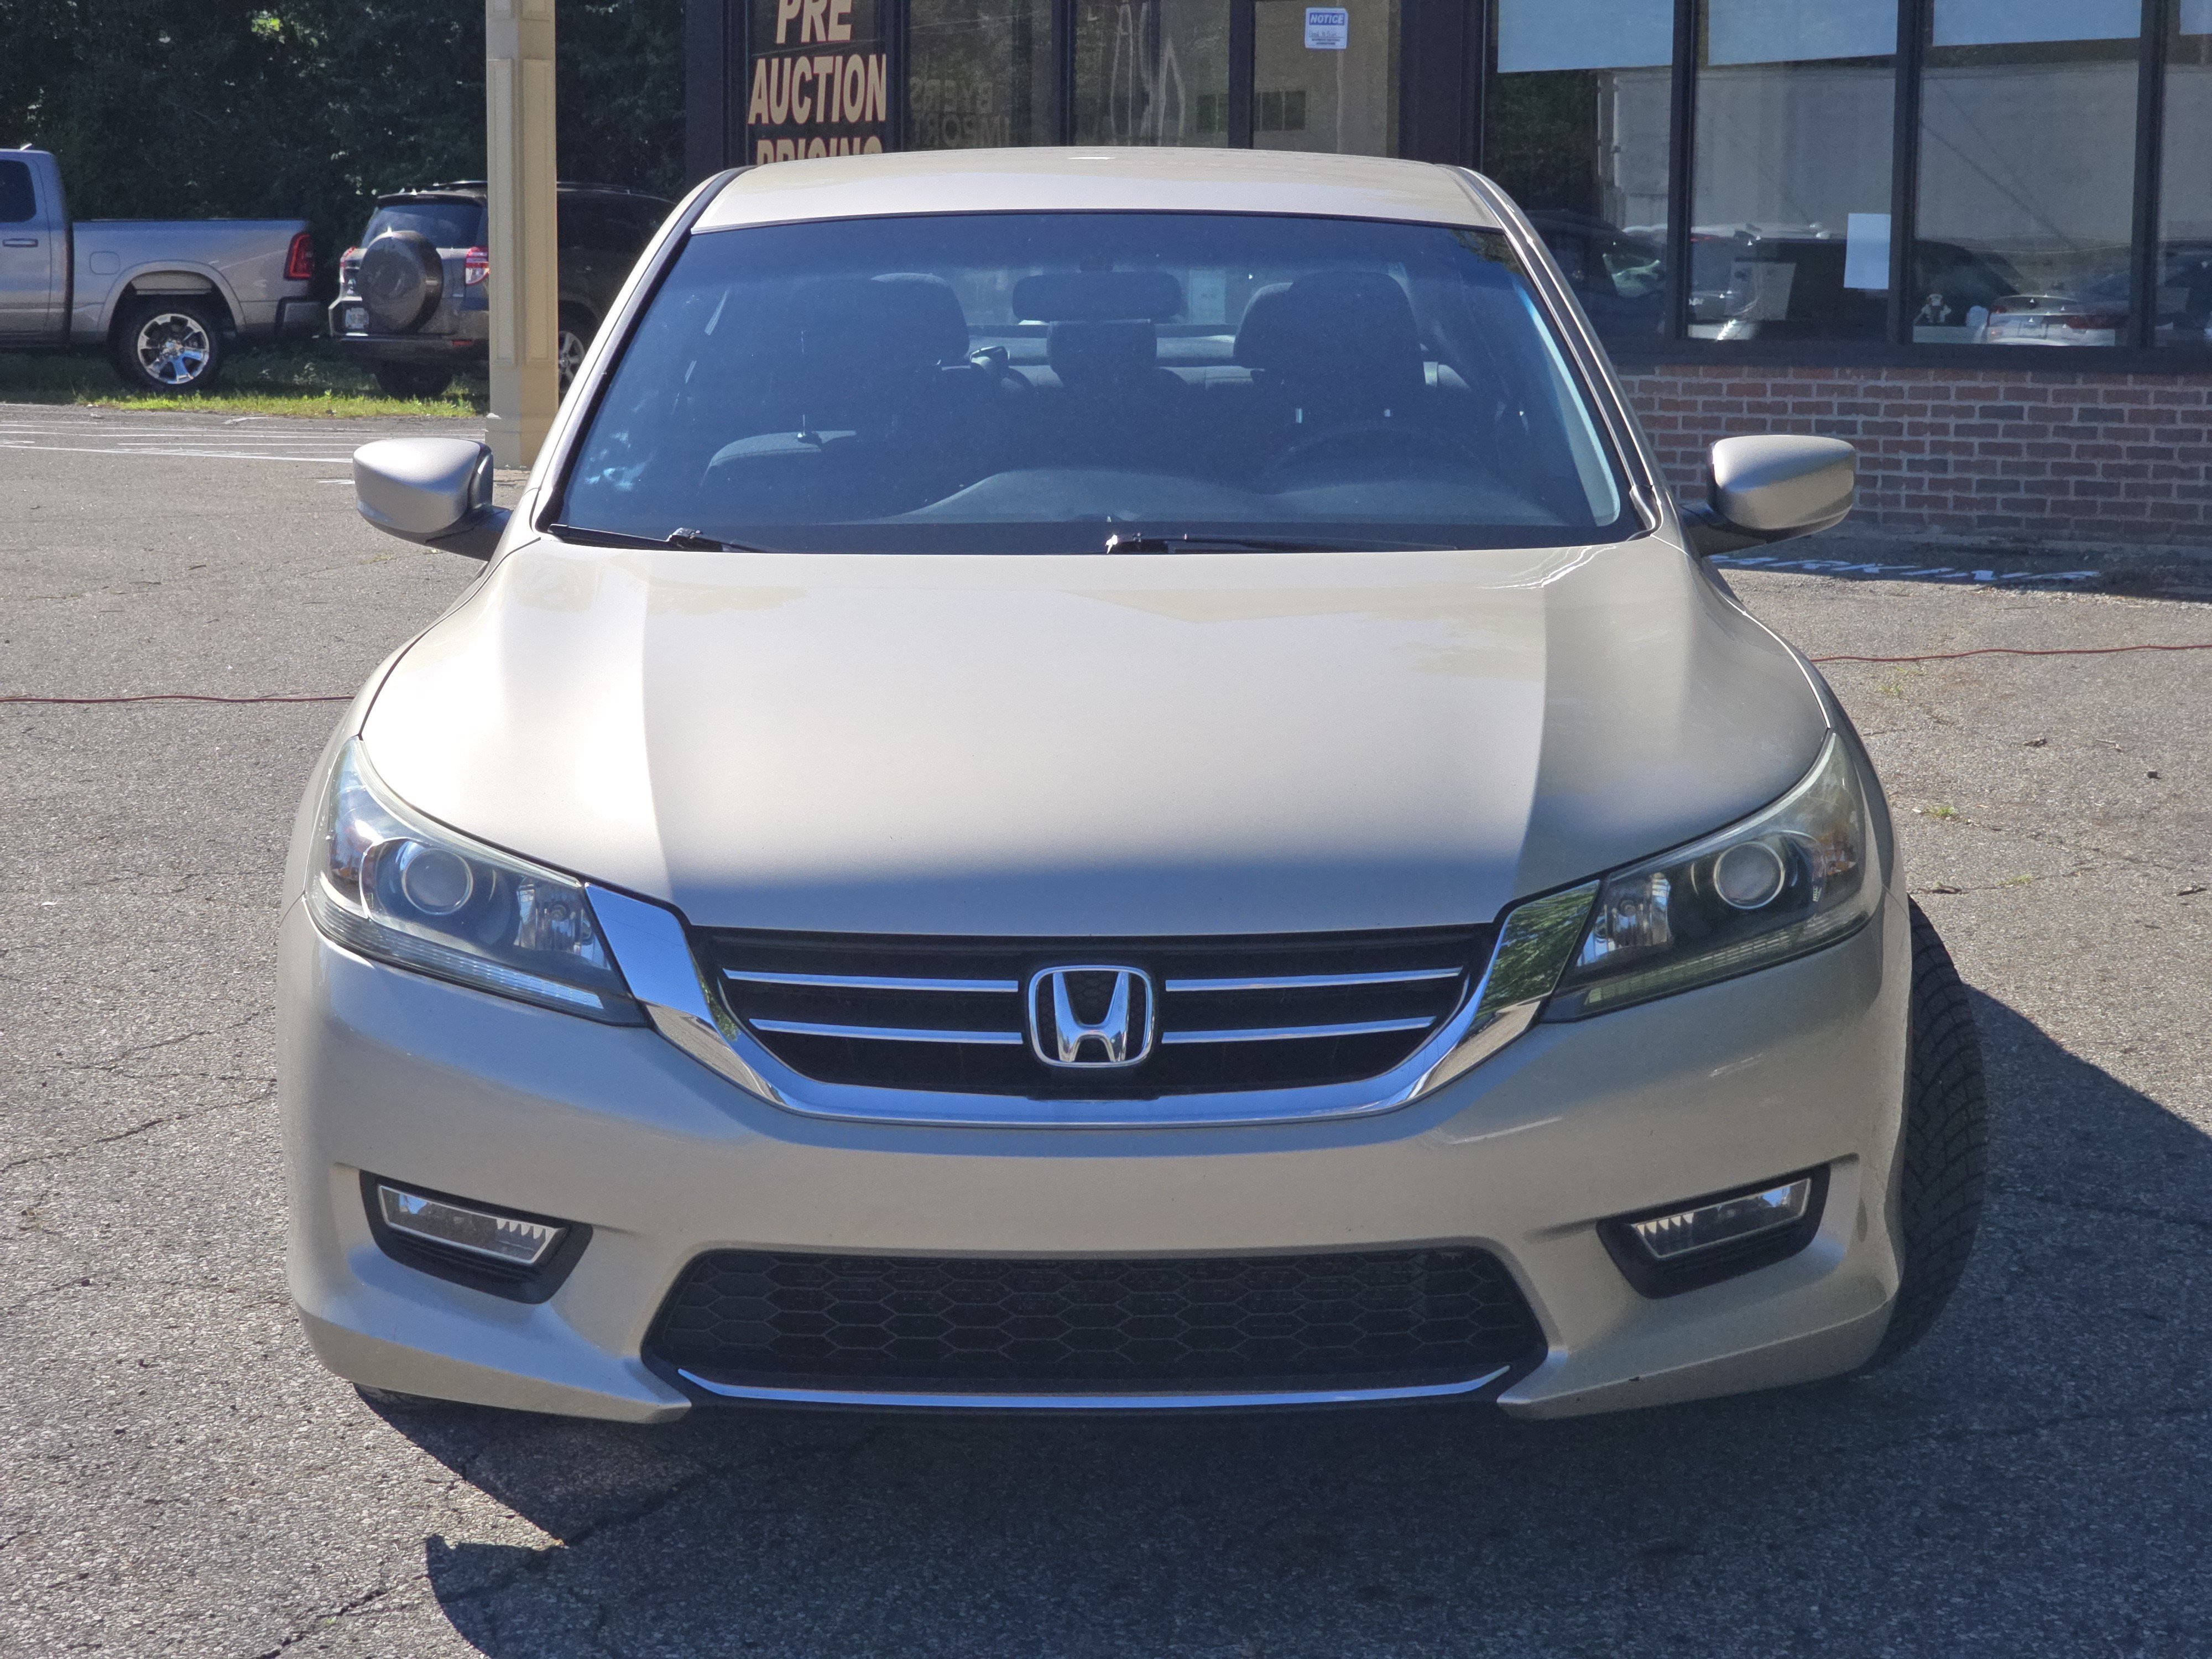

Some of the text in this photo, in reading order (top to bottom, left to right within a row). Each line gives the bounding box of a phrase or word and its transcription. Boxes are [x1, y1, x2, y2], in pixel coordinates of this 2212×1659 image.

[776, 0, 852, 44] PRE
[1310, 14, 1344, 24] NOTICE
[748, 54, 886, 124] AUCTION
